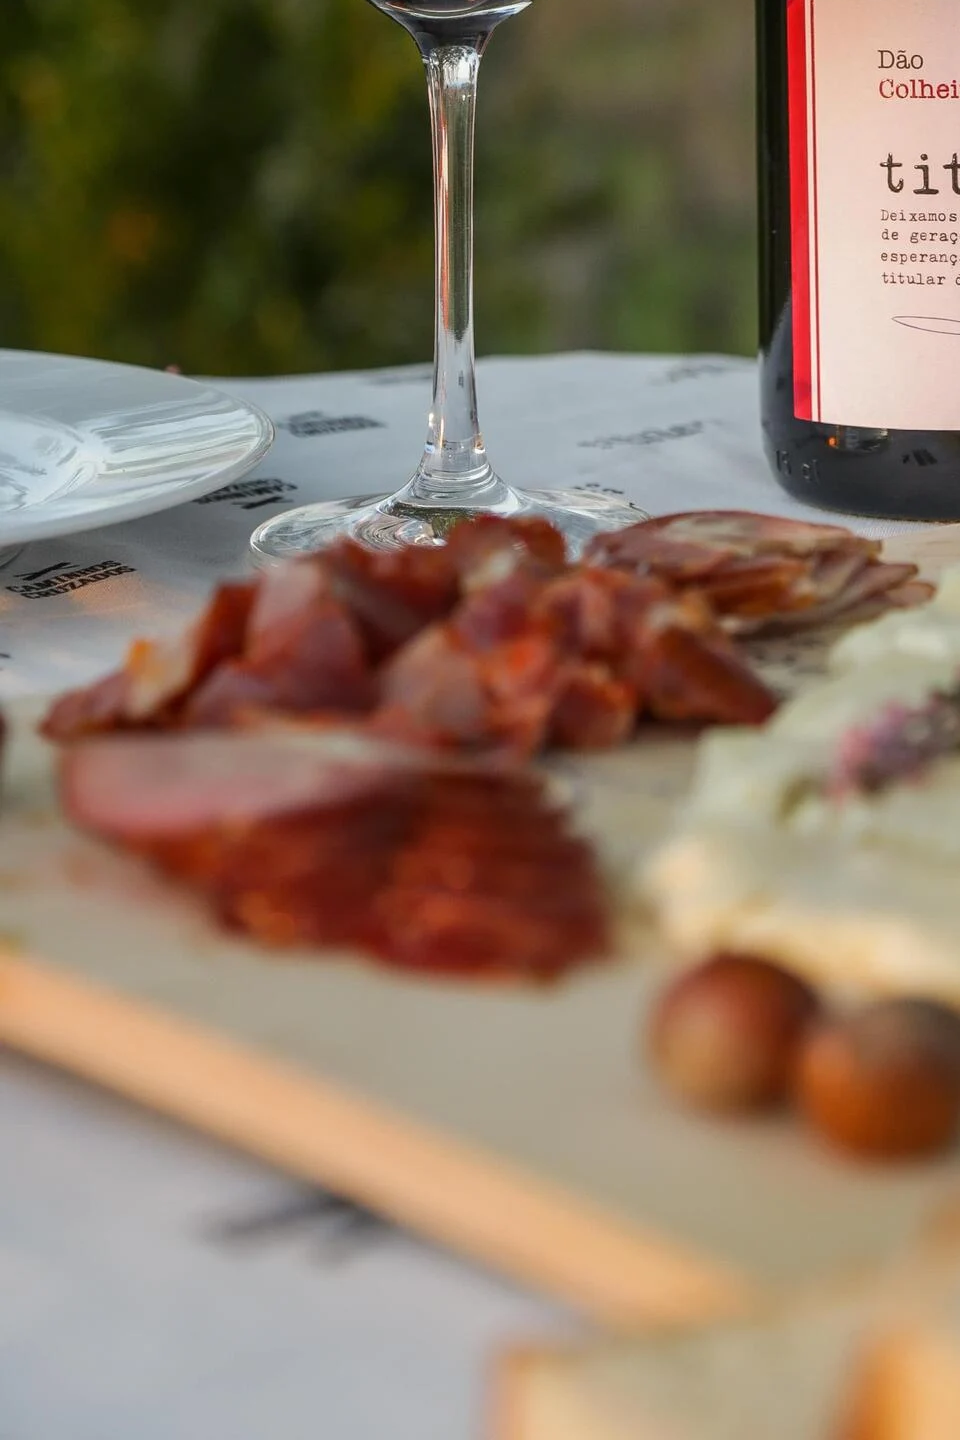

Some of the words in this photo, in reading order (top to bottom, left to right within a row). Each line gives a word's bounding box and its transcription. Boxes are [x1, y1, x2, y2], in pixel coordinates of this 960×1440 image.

[877, 49, 924, 70] Dão
[881, 209, 958, 222] Deixamos
[881, 229, 899, 241] de
[882, 272, 946, 285] titular
